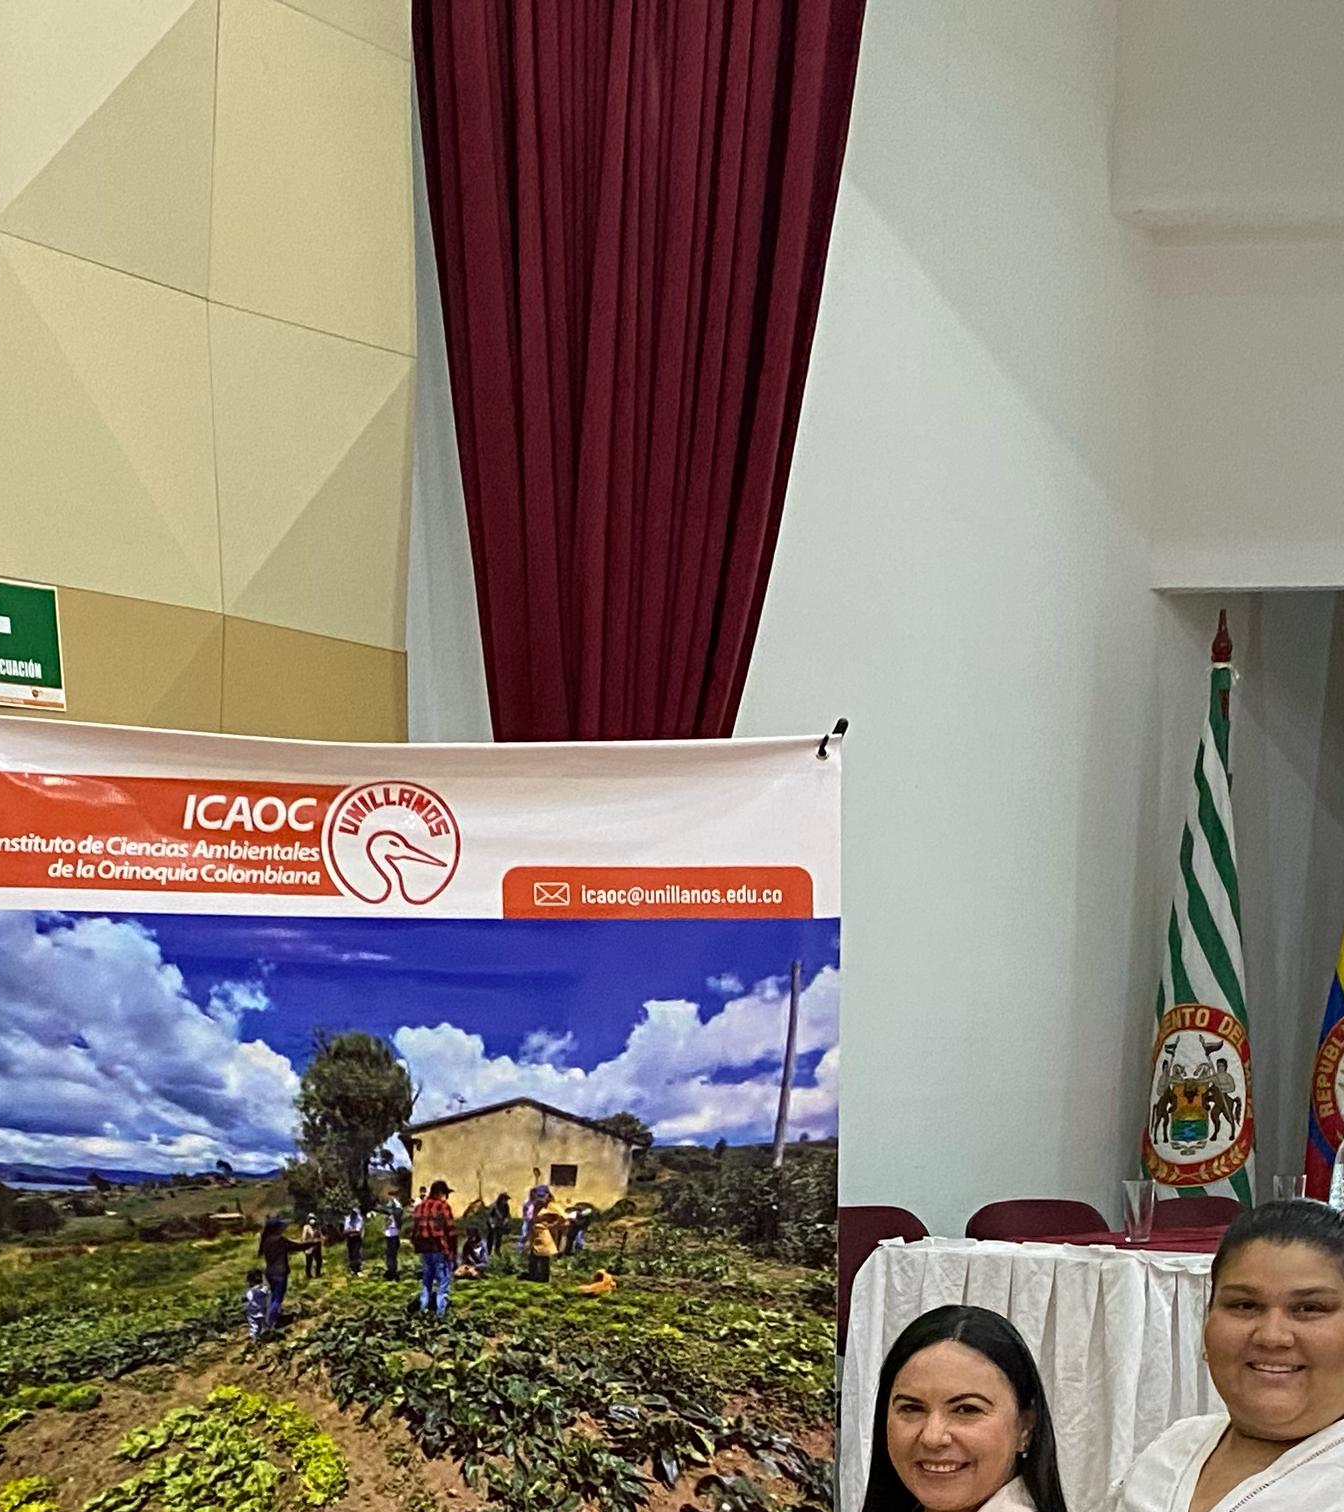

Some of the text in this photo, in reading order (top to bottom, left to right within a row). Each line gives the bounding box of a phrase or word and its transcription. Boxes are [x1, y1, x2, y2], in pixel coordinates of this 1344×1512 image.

[183, 793, 317, 833] ICAOC
[338, 786, 451, 838] UNILLANOS
[77, 834, 103, 856] de
[105, 835, 188, 859] Ciencias
[196, 839, 320, 863] Ambientales
[47, 858, 321, 886] de la Orinoquia Colombiana
[581, 884, 783, 906] icaoc@unillanos.edu.co
